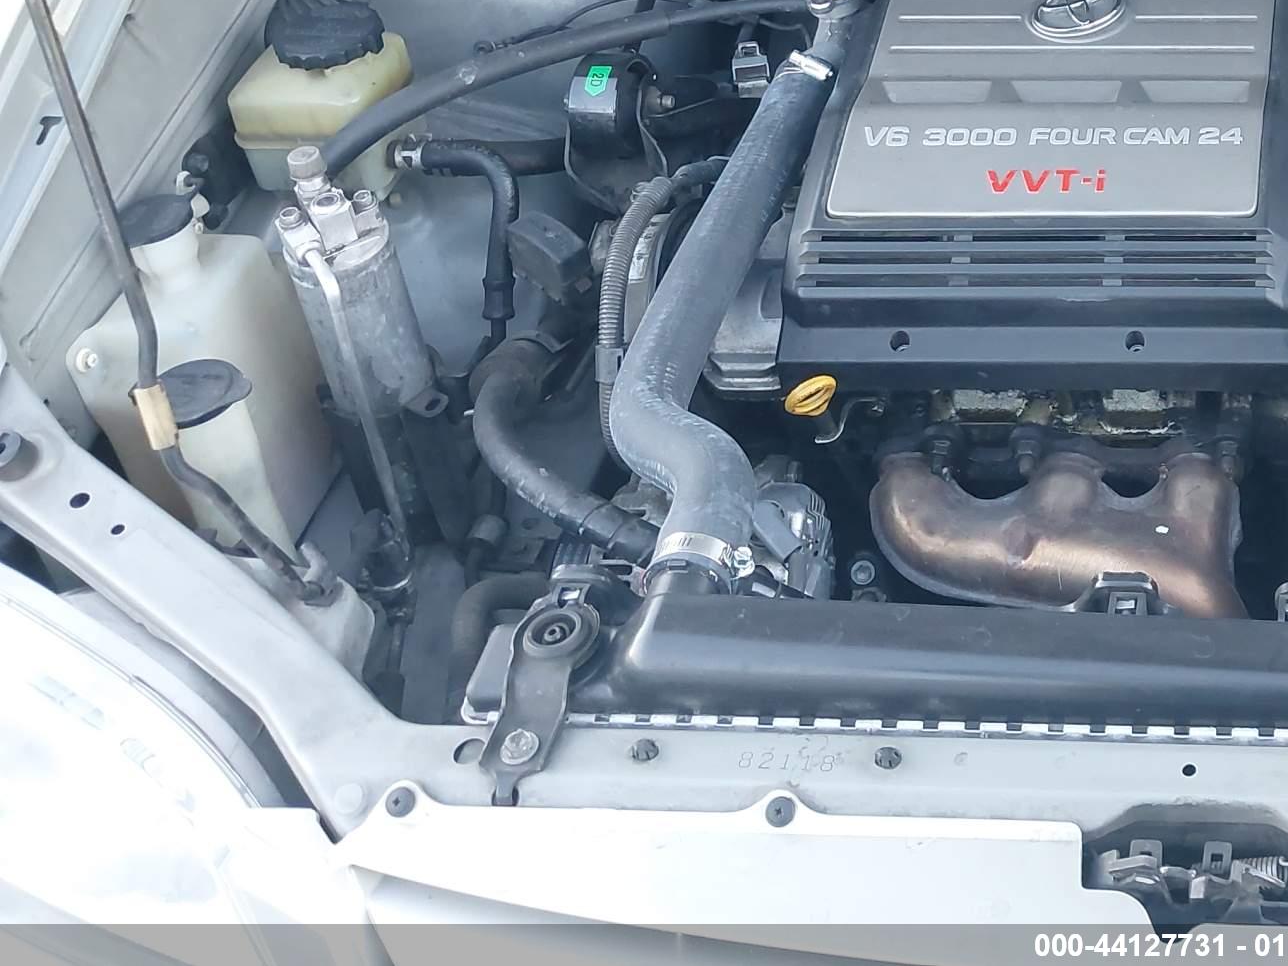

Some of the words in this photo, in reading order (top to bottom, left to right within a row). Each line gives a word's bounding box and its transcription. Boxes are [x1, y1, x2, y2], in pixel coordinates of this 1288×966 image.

[590, 72, 605, 87] 2D
[864, 126, 910, 147] V6
[922, 127, 1017, 146] 3000
[1028, 127, 1116, 146] FOUR
[1123, 127, 1190, 146] CAM
[1198, 127, 1243, 146] 24
[986, 168, 1106, 194] VVT-i
[737, 750, 836, 772] 82118
